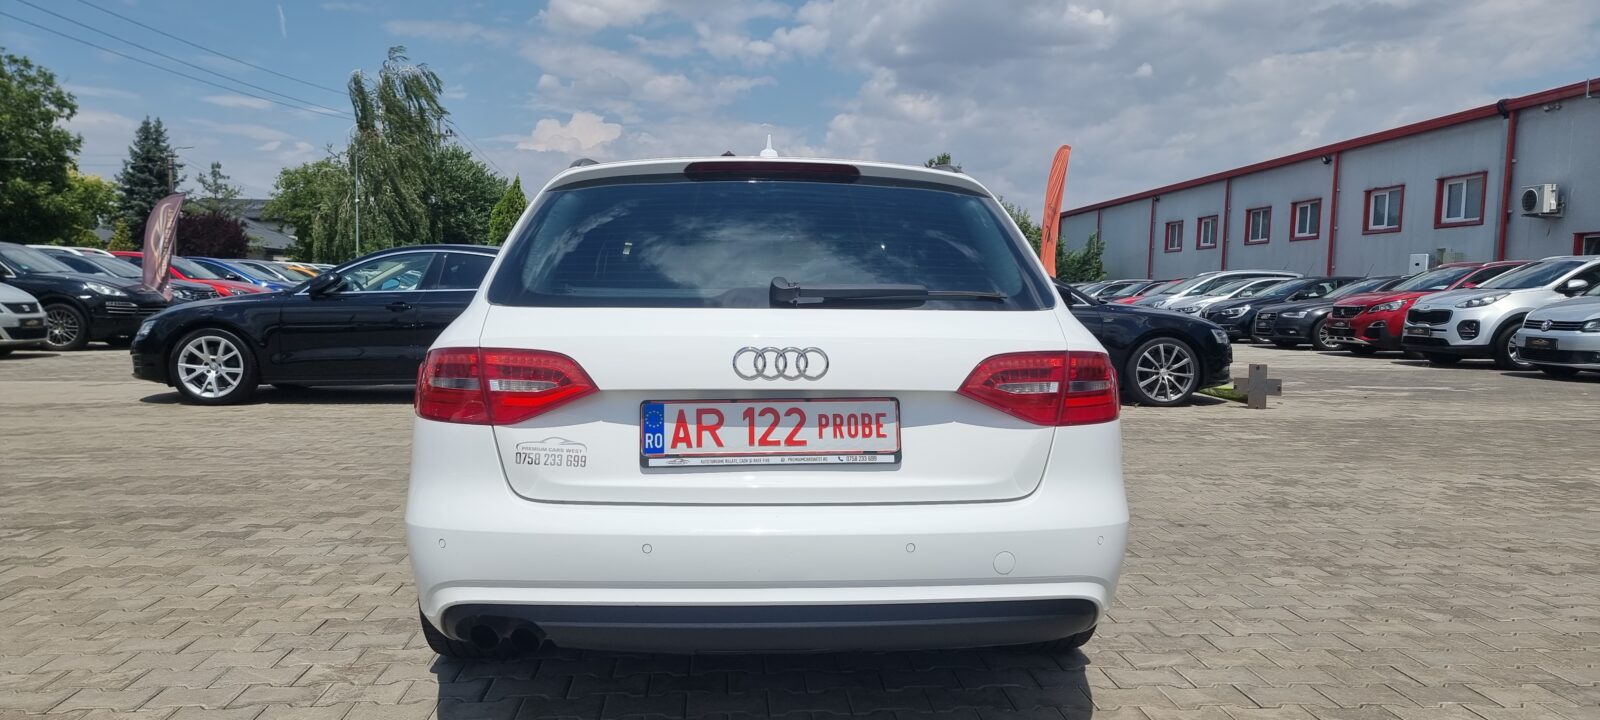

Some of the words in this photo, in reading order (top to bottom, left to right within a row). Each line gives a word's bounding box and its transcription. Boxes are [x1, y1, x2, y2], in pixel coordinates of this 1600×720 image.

[670, 408, 725, 449] AR
[742, 407, 807, 447] 122
[818, 412, 888, 440] PROBE
[645, 433, 663, 449] RO
[515, 452, 541, 465] 0758
[544, 453, 563, 466] 233
[566, 454, 587, 467] 699
